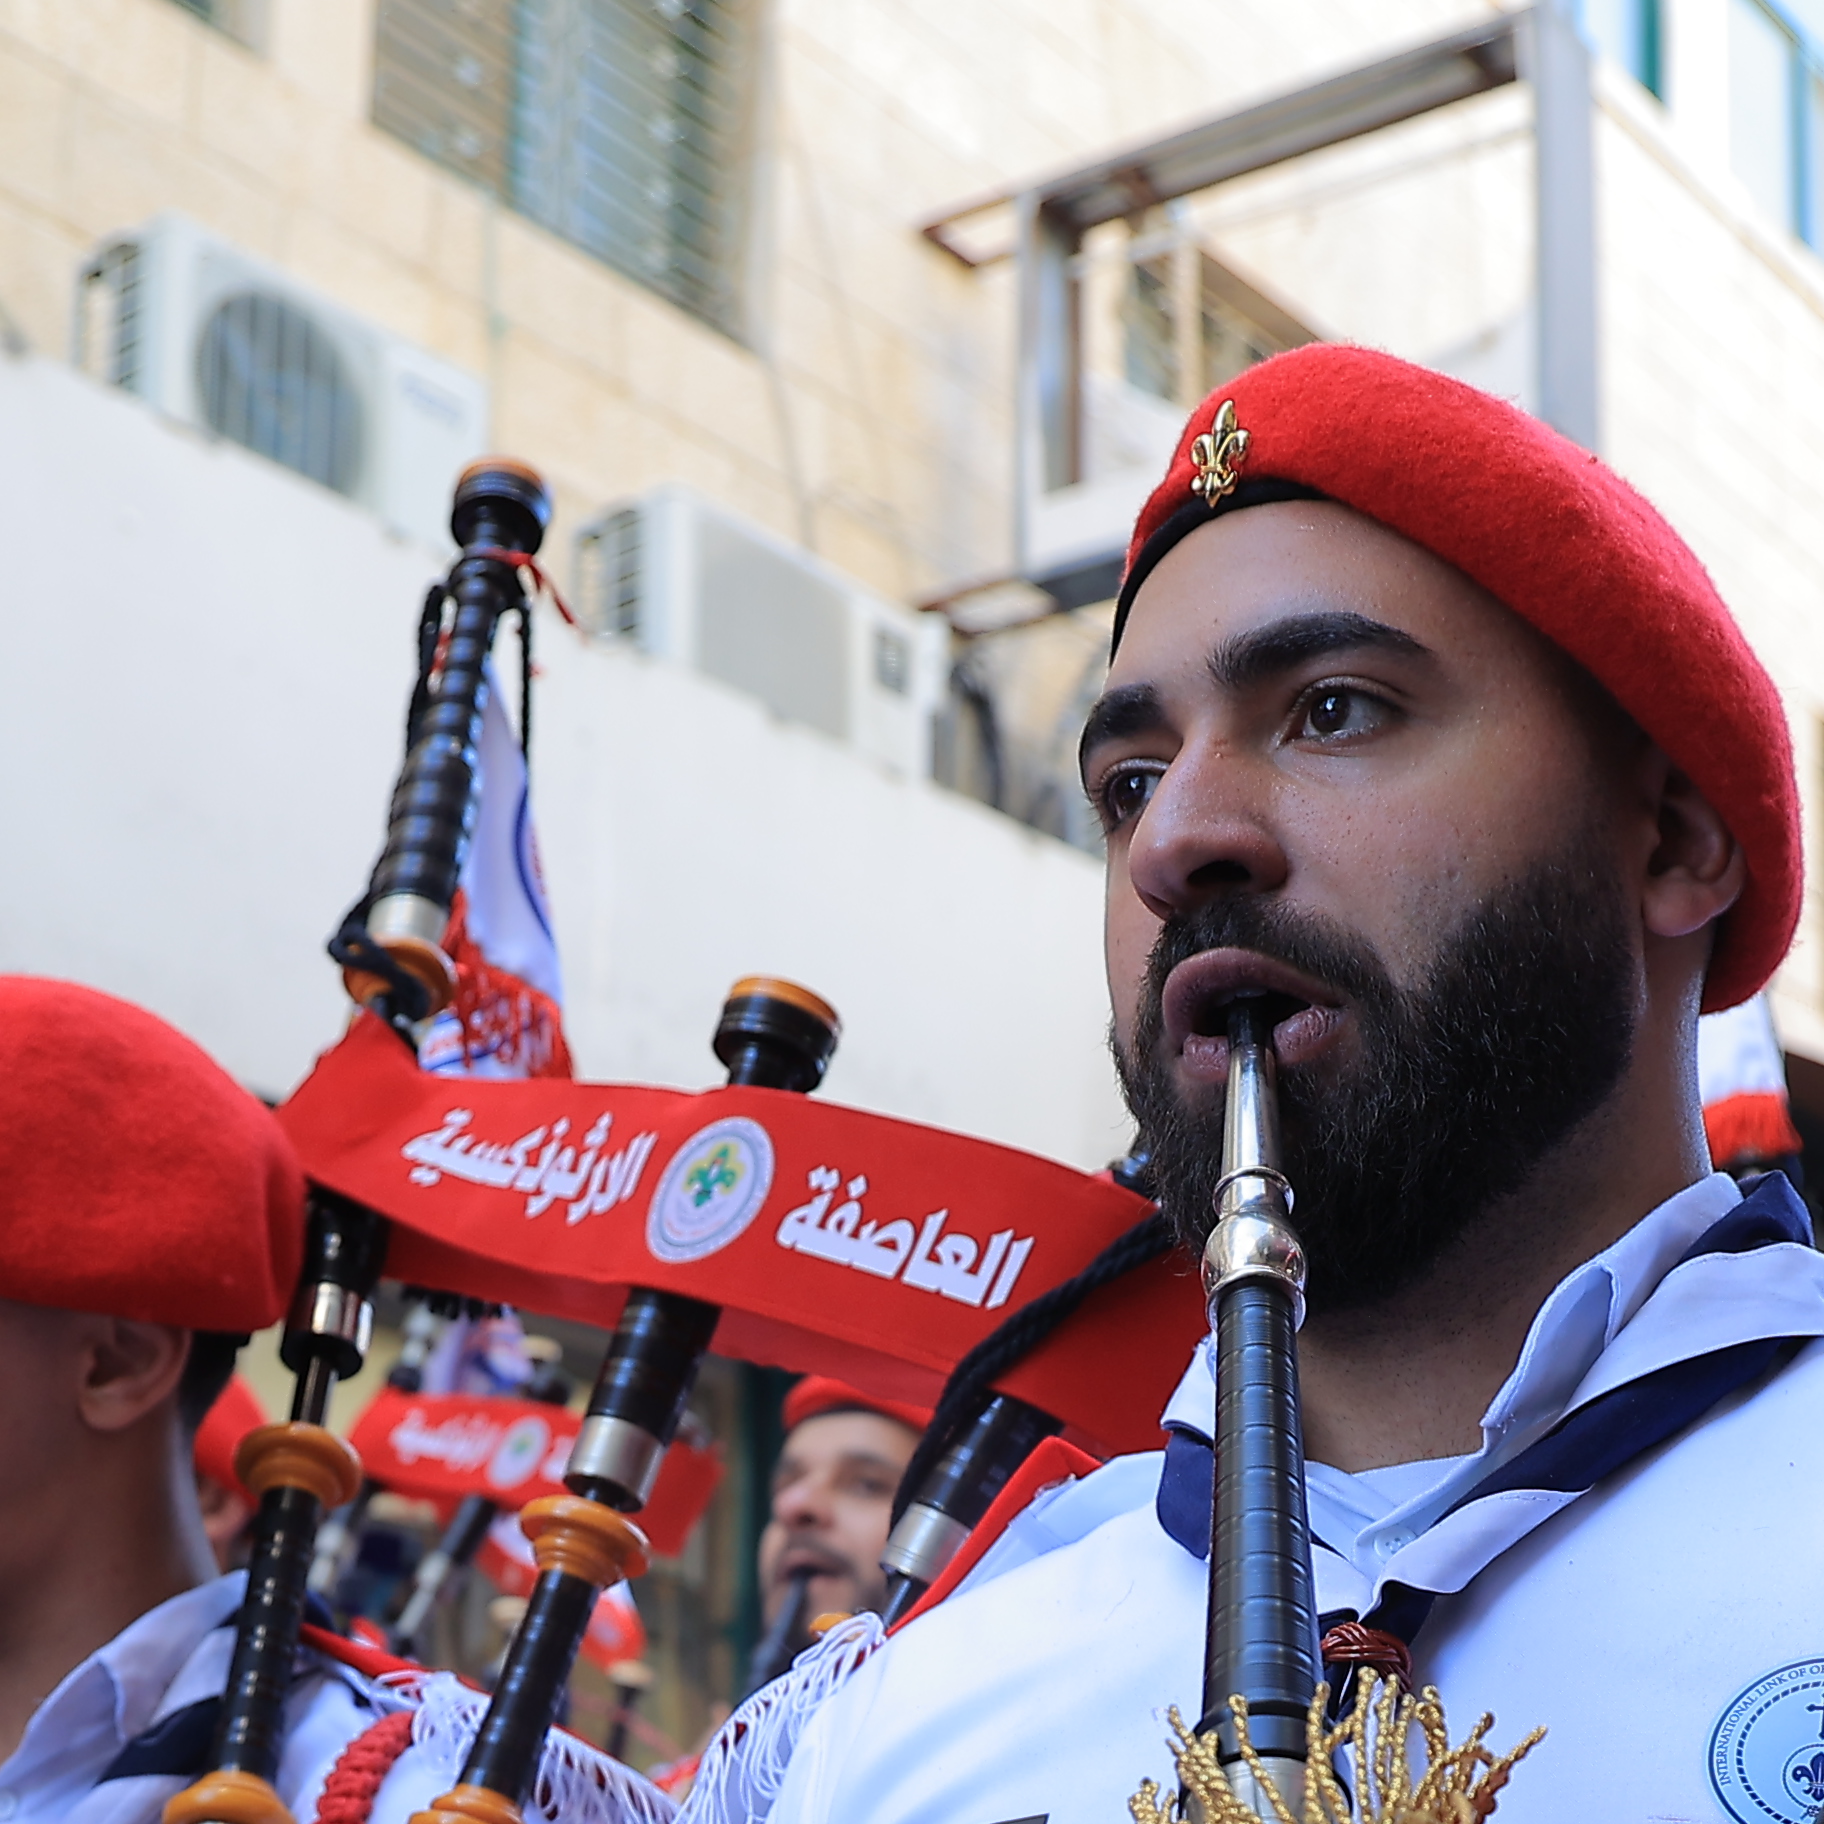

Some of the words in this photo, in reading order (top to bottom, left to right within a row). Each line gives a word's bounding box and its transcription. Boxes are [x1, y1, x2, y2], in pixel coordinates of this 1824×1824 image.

[775, 1164, 1036, 1311] العاصفة
[1716, 1695, 1760, 1786] INTERNATIONAL
[1755, 1674, 1788, 1697] LINK
[1788, 1667, 1806, 1680] OF
